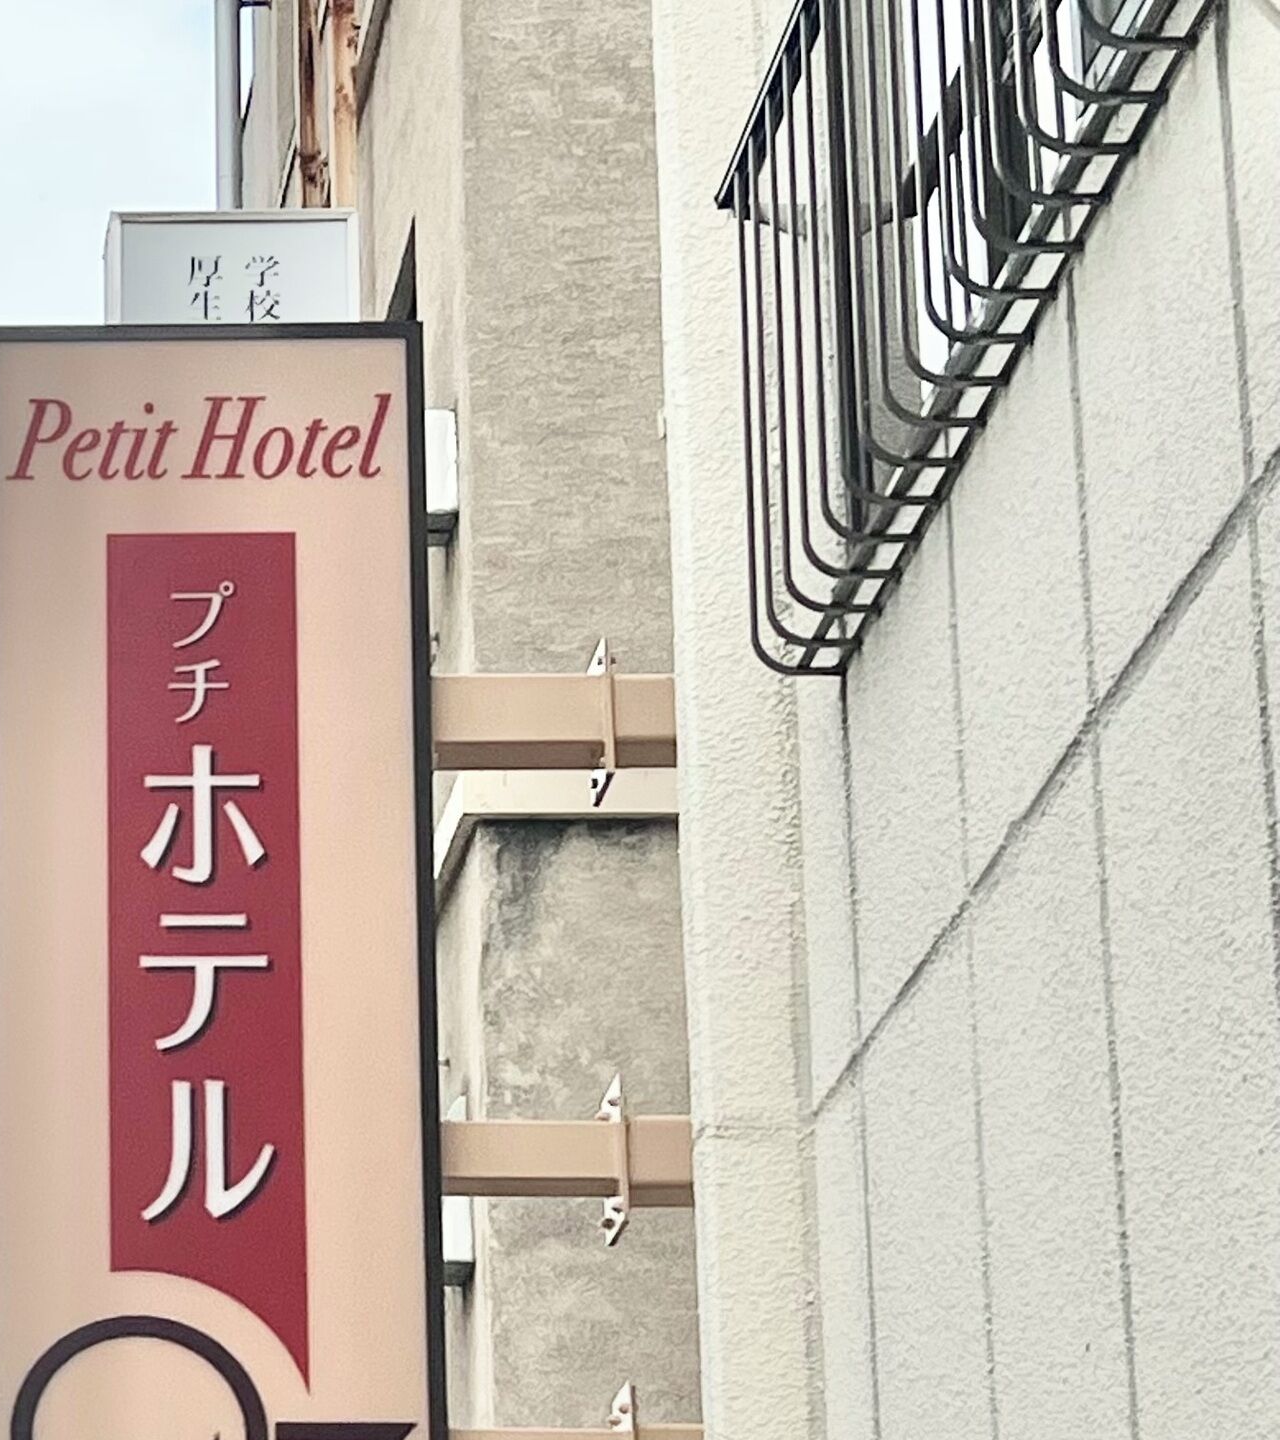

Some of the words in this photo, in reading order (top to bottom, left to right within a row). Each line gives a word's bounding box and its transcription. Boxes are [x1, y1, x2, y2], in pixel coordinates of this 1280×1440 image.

[243, 254, 281, 321] 学校
[5, 399, 178, 483] Petit
[181, 393, 393, 482] Hotel
